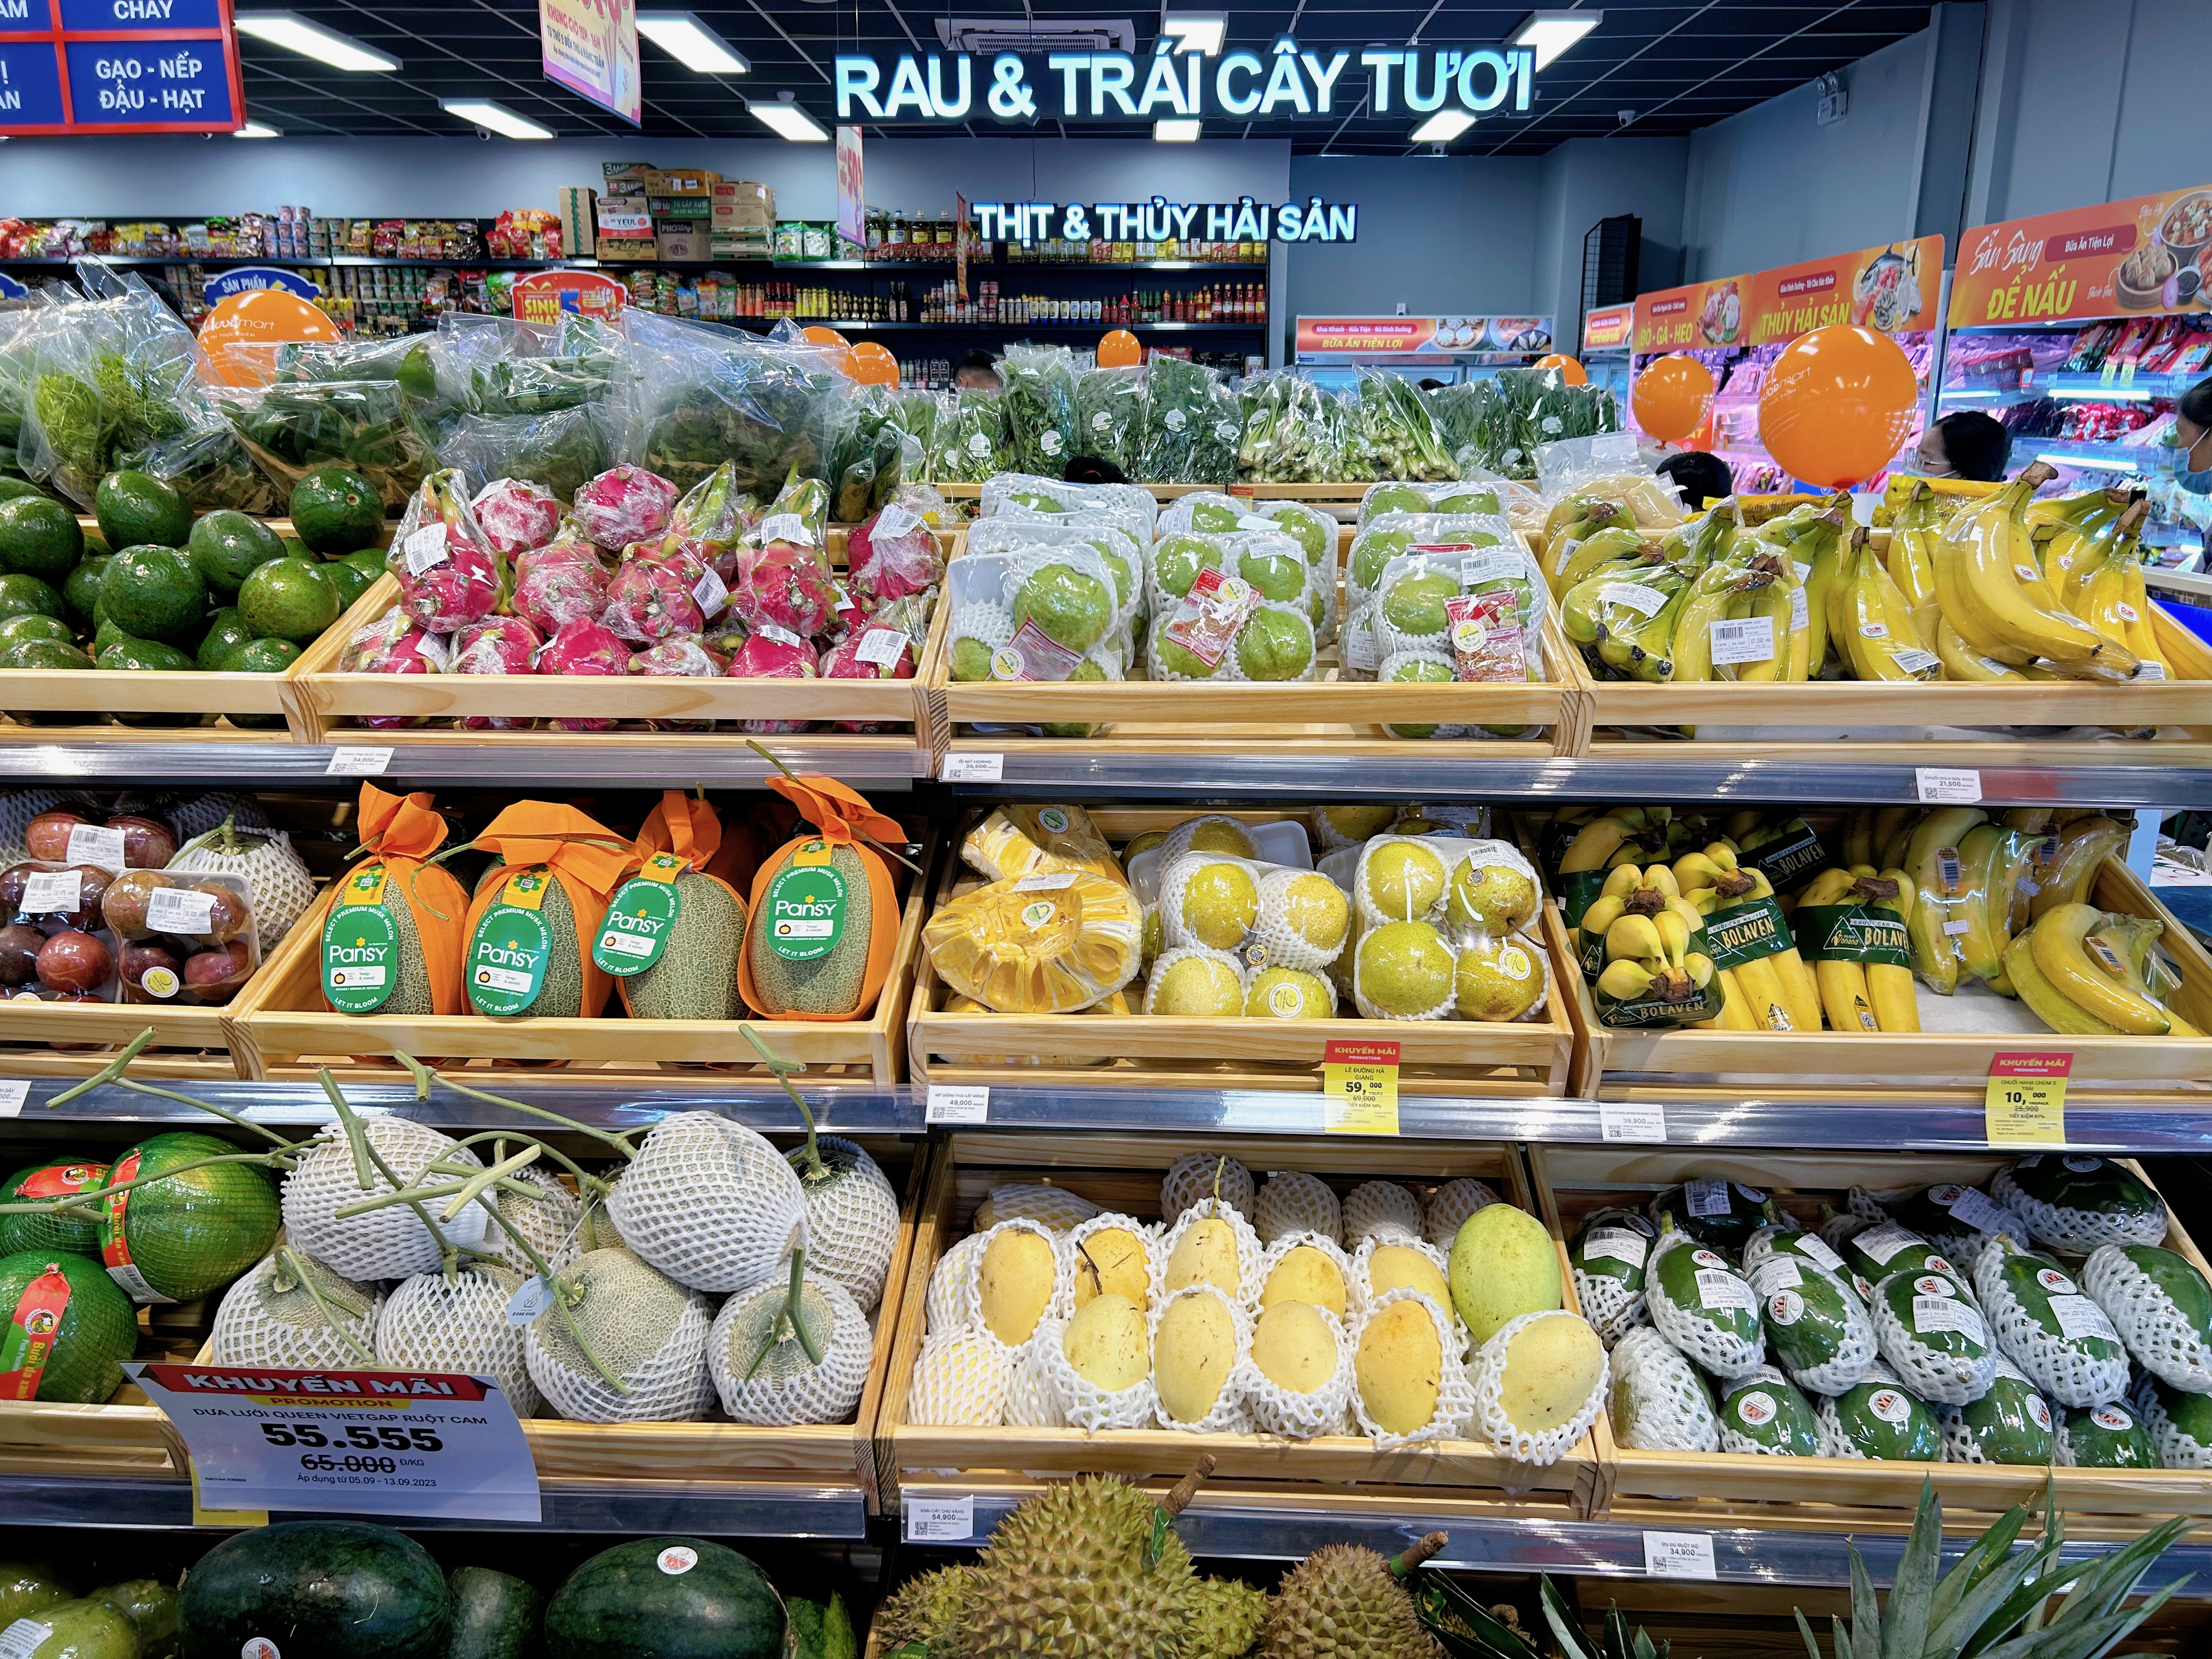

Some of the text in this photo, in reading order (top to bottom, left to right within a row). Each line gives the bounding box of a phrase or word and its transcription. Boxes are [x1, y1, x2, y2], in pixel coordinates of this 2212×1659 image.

[114, 0, 173, 19] CHAY
[547, 3, 568, 29] KHUNG
[96, 59, 142, 84] GẠO
[159, 50, 202, 78] NẾP
[836, 39, 1533, 118] RAU & TRÁI CÂY TƯƠI
[99, 83, 144, 114] ĐẬU
[163, 90, 205, 114] HẠT
[973, 197, 1356, 247] THỊT & THỦY HẢI SẢN
[2002, 229, 2045, 272] Sàng
[2088, 236, 2102, 251] Tiện
[1987, 264, 2077, 320] ĐỂ NẤU
[524, 299, 560, 314] SINH
[1762, 302, 1794, 336] THỦY
[1640, 321, 1651, 347] BÒ
[1656, 318, 1668, 346] GÀ
[1674, 323, 1692, 344] HEO
[1322, 337, 1403, 350] BỮA ĂN TIỆN LỢI
[1778, 843, 1825, 874] BOLAVEN
[772, 867, 843, 898] SELECT PREMIUM MUSK MELON
[611, 881, 675, 918] SELECT PREMIUM MUSK MELON
[775, 900, 837, 917] Pansy
[325, 906, 393, 942] SELECT PREMIUM MUSK MELON
[477, 907, 548, 950] SELECT PREMIUM MUSK MELON
[607, 911, 664, 935] Pansy
[1708, 923, 1726, 934] CHUỐI
[1721, 916, 1775, 949] BOLAVEN
[330, 945, 388, 963] Pansy
[477, 942, 539, 968] Pansy
[778, 946, 791, 955] LET
[799, 946, 824, 957] BLOOM
[597, 957, 608, 967] LET
[614, 965, 639, 973] BLOOM
[334, 997, 346, 1007] LET
[355, 997, 378, 1009] BLOOM
[476, 995, 487, 1006] LET
[494, 1003, 519, 1012] BLOOM
[1640, 1000, 1705, 1019] BOLAVEN
[1335, 1046, 1396, 1055] KHUYẾN MÃI
[2000, 1058, 2065, 1066] KHUYẾN MÃI
[16, 1380, 30, 1400] xanh
[183, 1373, 455, 1395] KHUYẾN MÃI
[270, 1397, 393, 1408] PROMOTION
[193, 1407, 488, 1425] DƯA LƯỚI QUEEN VIETGAP RUỘT CAM
[260, 1423, 444, 1452] 55.555
[301, 1454, 425, 1474] 65.000 Đ/KG
[312, 1475, 336, 1486] dụng
[337, 1475, 347, 1484] từ
[383, 1477, 437, 1487] 13.09.2023
